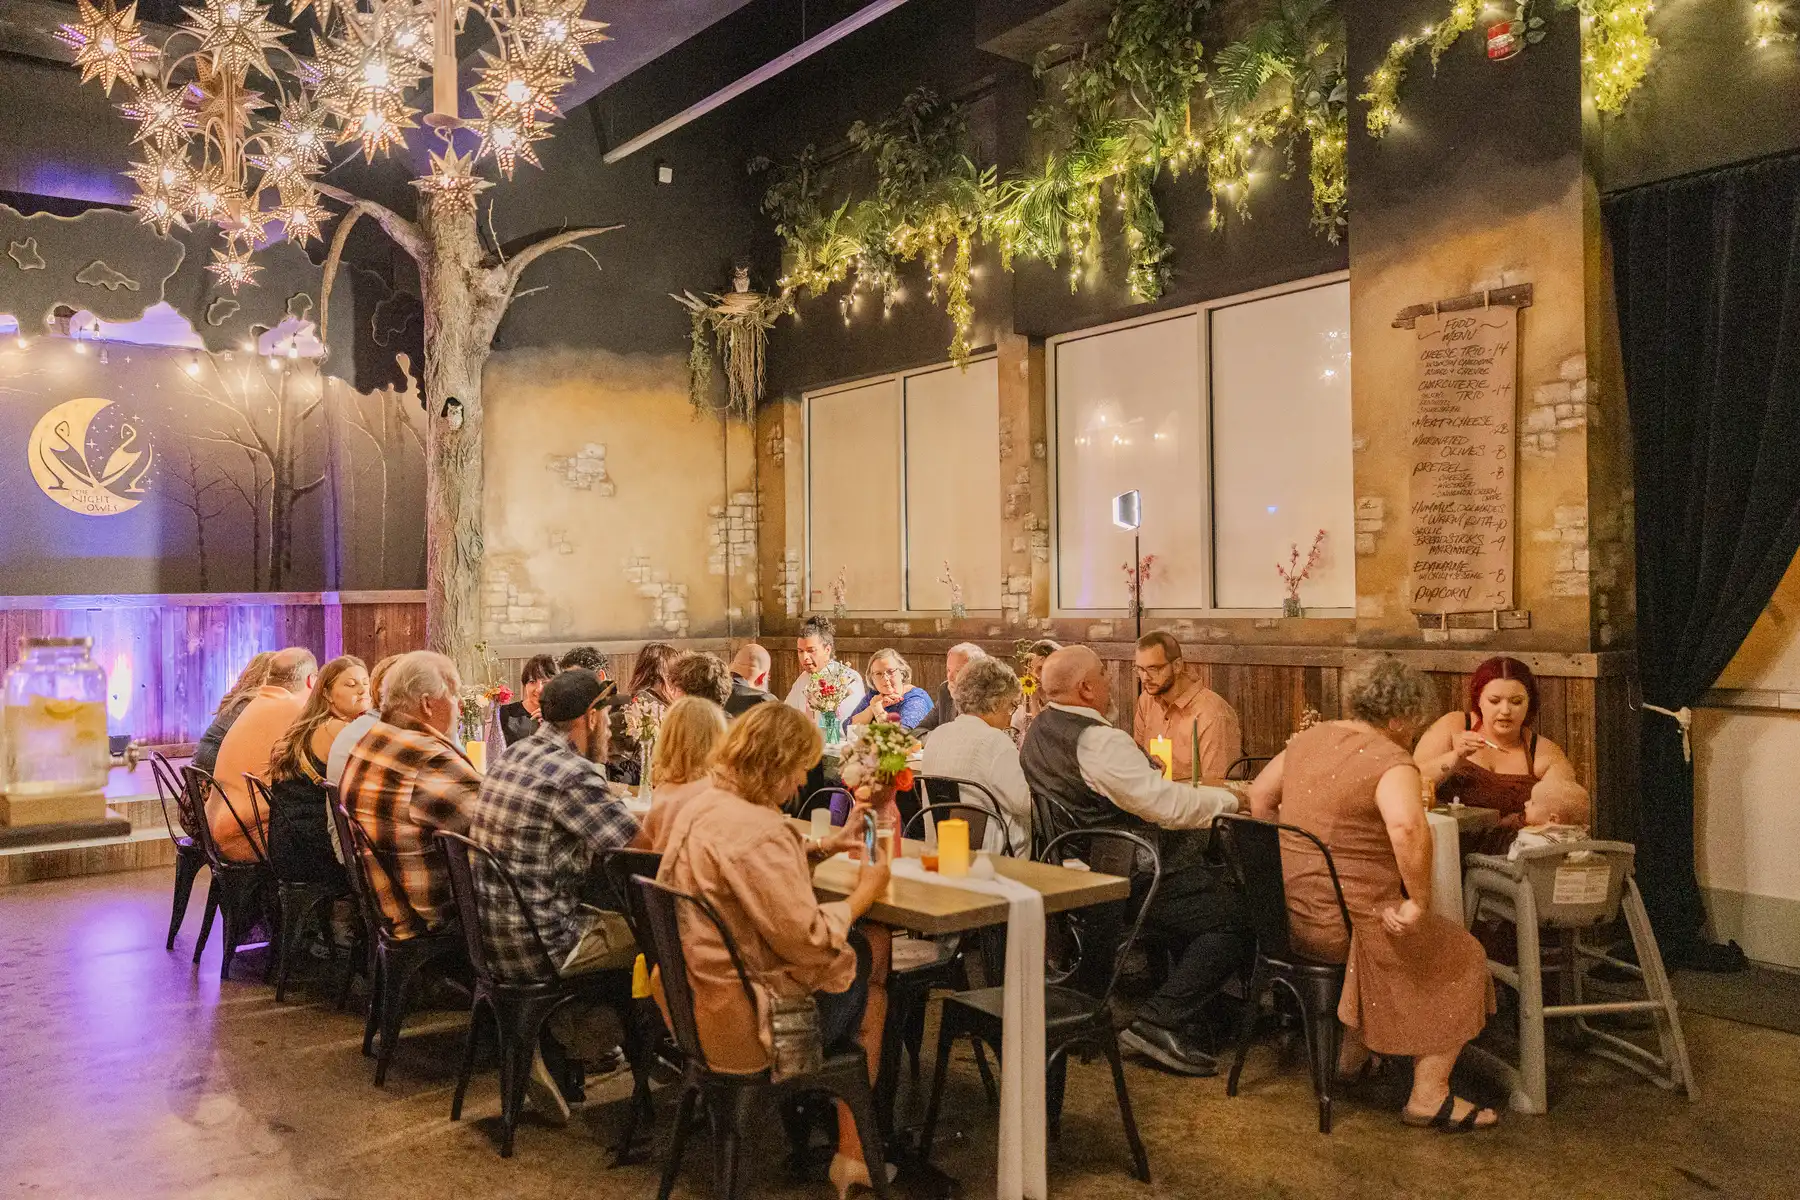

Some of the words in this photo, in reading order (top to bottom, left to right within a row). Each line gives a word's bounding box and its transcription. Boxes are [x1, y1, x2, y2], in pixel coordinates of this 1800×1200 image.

[1443, 318, 1477, 333] FOOD
[1441, 329, 1478, 346] MENU
[1420, 347, 1457, 361] CHEESE
[1461, 344, 1485, 358] TRIO
[1417, 379, 1490, 391] CHARCUTERIE
[1455, 390, 1485, 401] TRIO
[1412, 433, 1470, 446] MARINATED
[1440, 444, 1486, 458] OLIVES
[1412, 462, 1470, 477] PRETZEL
[71, 495, 110, 504] NIGHT
[86, 504, 118, 512] OWLS
[1427, 512, 1466, 526] WARM
[1414, 585, 1472, 604] POPCORN
